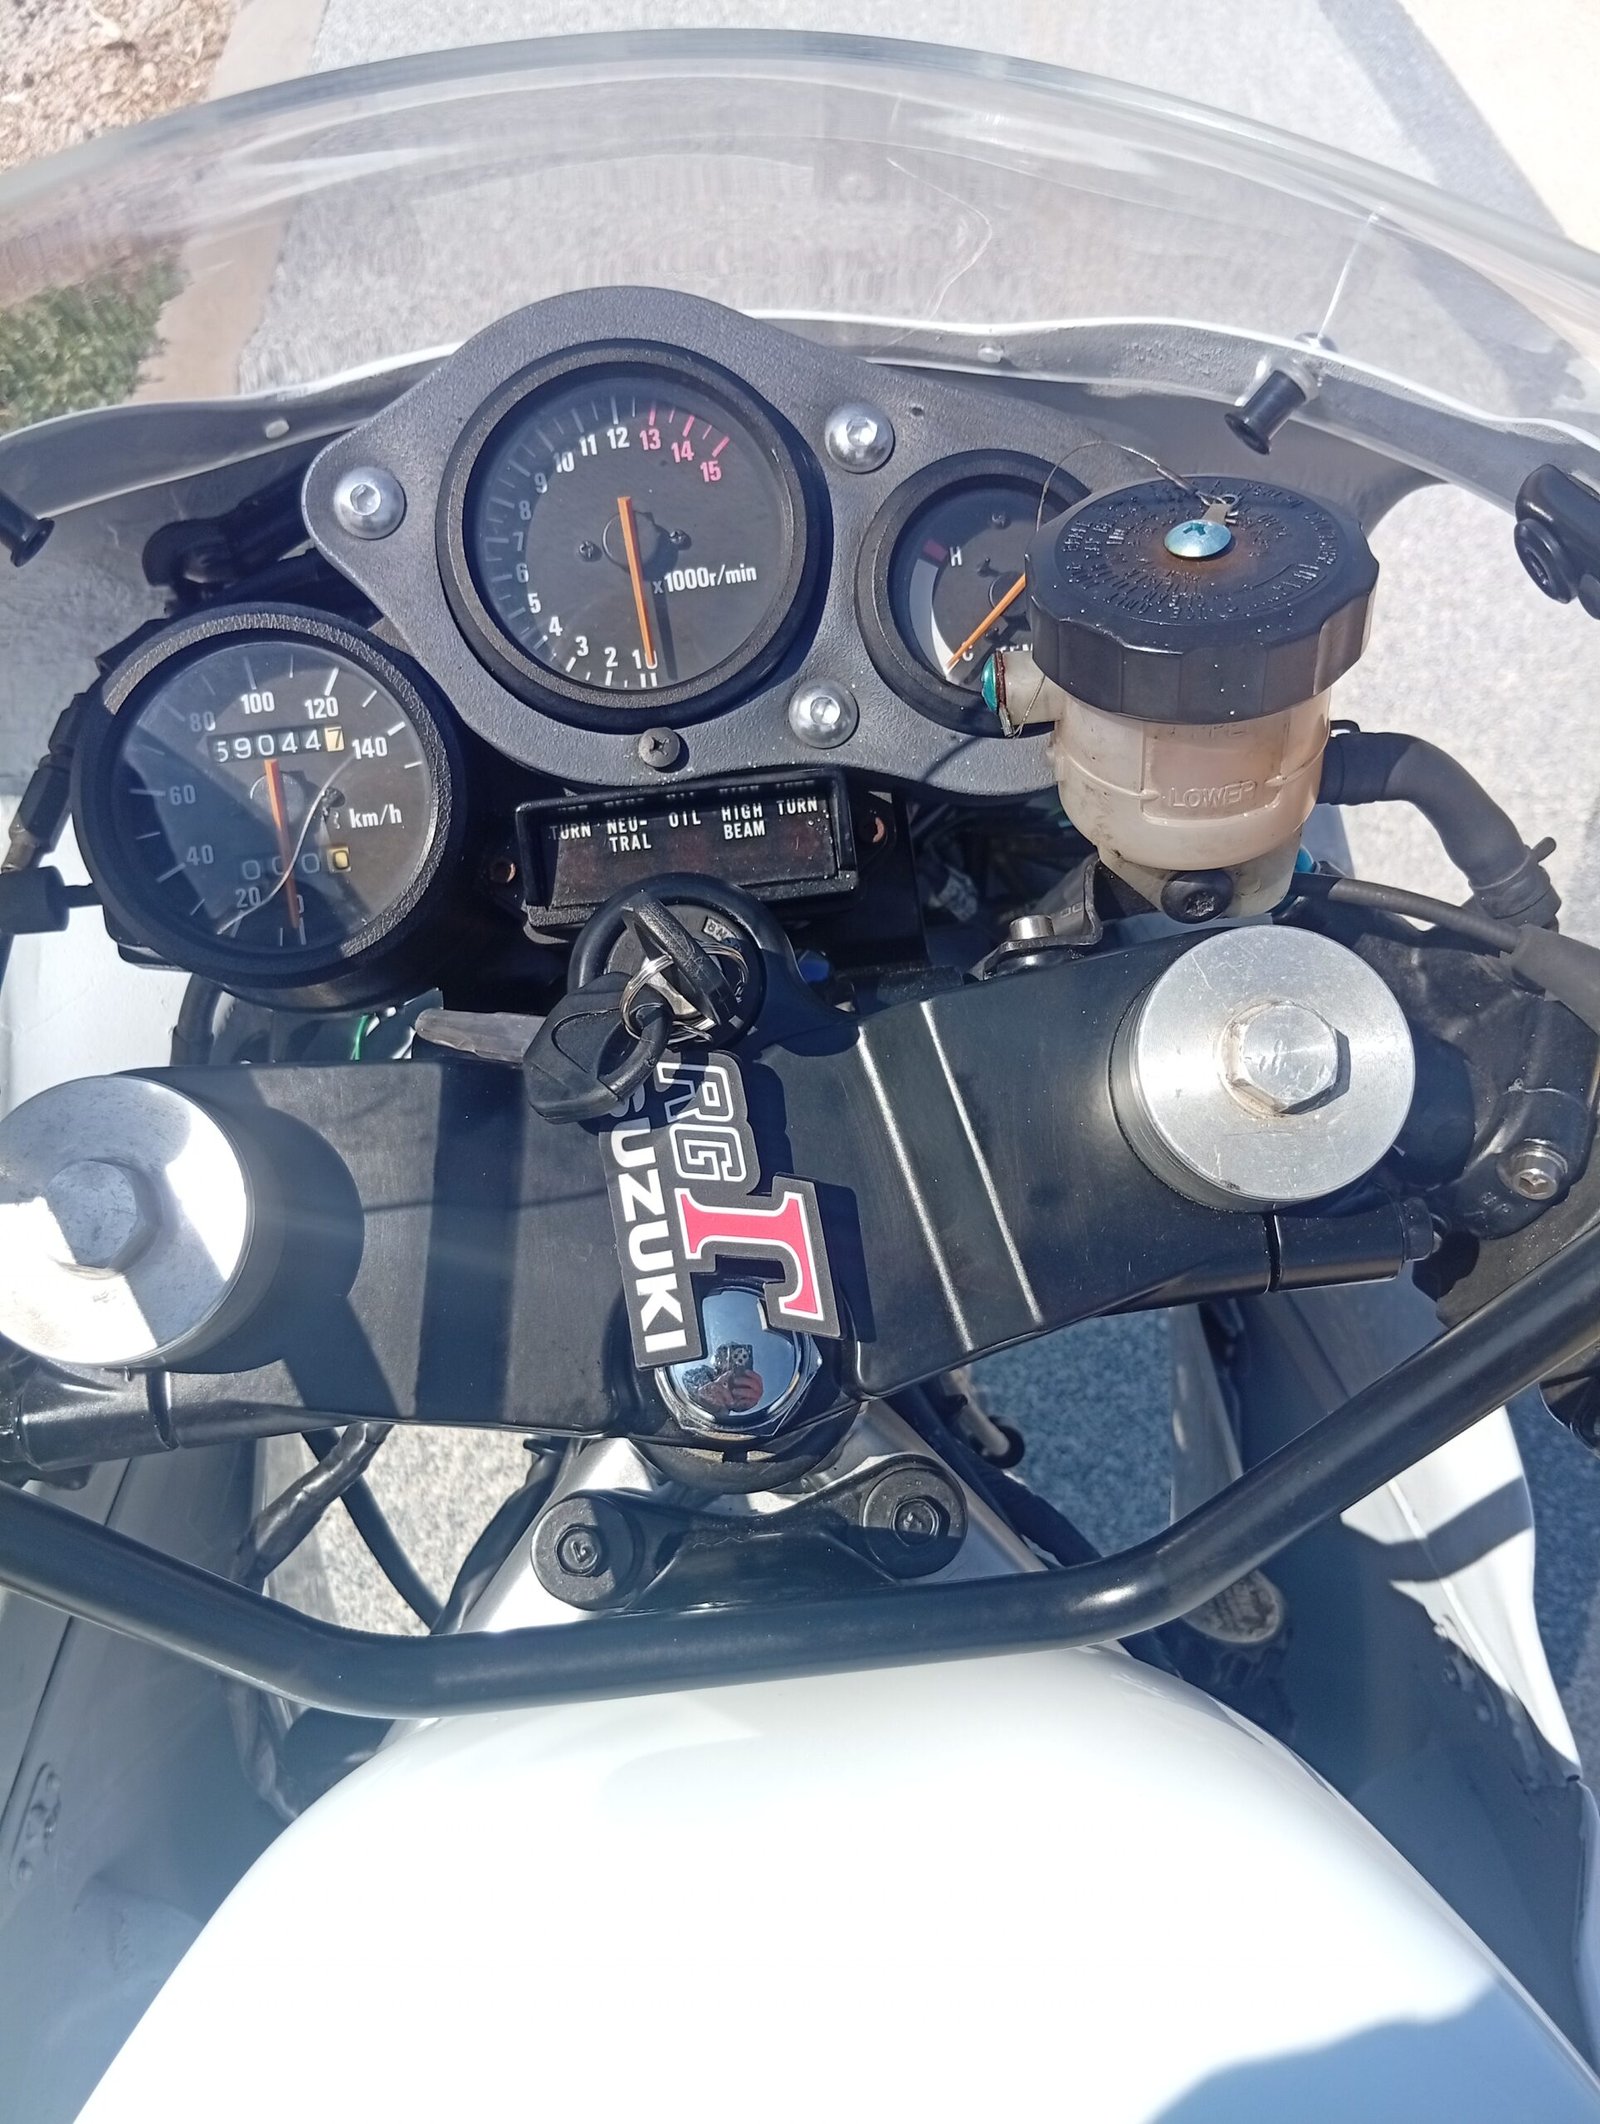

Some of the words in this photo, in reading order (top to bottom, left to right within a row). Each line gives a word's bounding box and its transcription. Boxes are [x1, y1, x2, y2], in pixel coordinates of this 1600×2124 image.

[578, 434, 599, 457] 11
[606, 426, 630, 450] 12
[639, 429, 662, 451] 13
[553, 451, 576, 473] 10
[670, 440, 695, 463] 14
[700, 460, 722, 482] 15
[533, 472, 549, 494] 9
[518, 500, 532, 521] 8
[512, 532, 525, 551] 7
[949, 546, 963, 567] H
[515, 563, 529, 583] 6
[527, 592, 542, 614] 5
[548, 616, 563, 637] 4
[575, 635, 590, 657] 3
[604, 647, 619, 668] 2
[631, 649, 642, 670] 1
[240, 691, 275, 716] 100
[304, 696, 339, 720] 120
[188, 711, 216, 732] 80
[215, 727, 344, 762] 590447
[352, 736, 388, 760] 140
[169, 784, 196, 805] 60
[349, 803, 402, 829] km/h
[549, 821, 592, 840] TURN
[668, 808, 701, 829] OIL
[720, 803, 764, 821] HIGH
[775, 796, 819, 817] TURN
[723, 820, 766, 840] BEAM
[608, 833, 652, 853] TRAL
[186, 845, 214, 867] 40
[235, 886, 263, 908] 20
